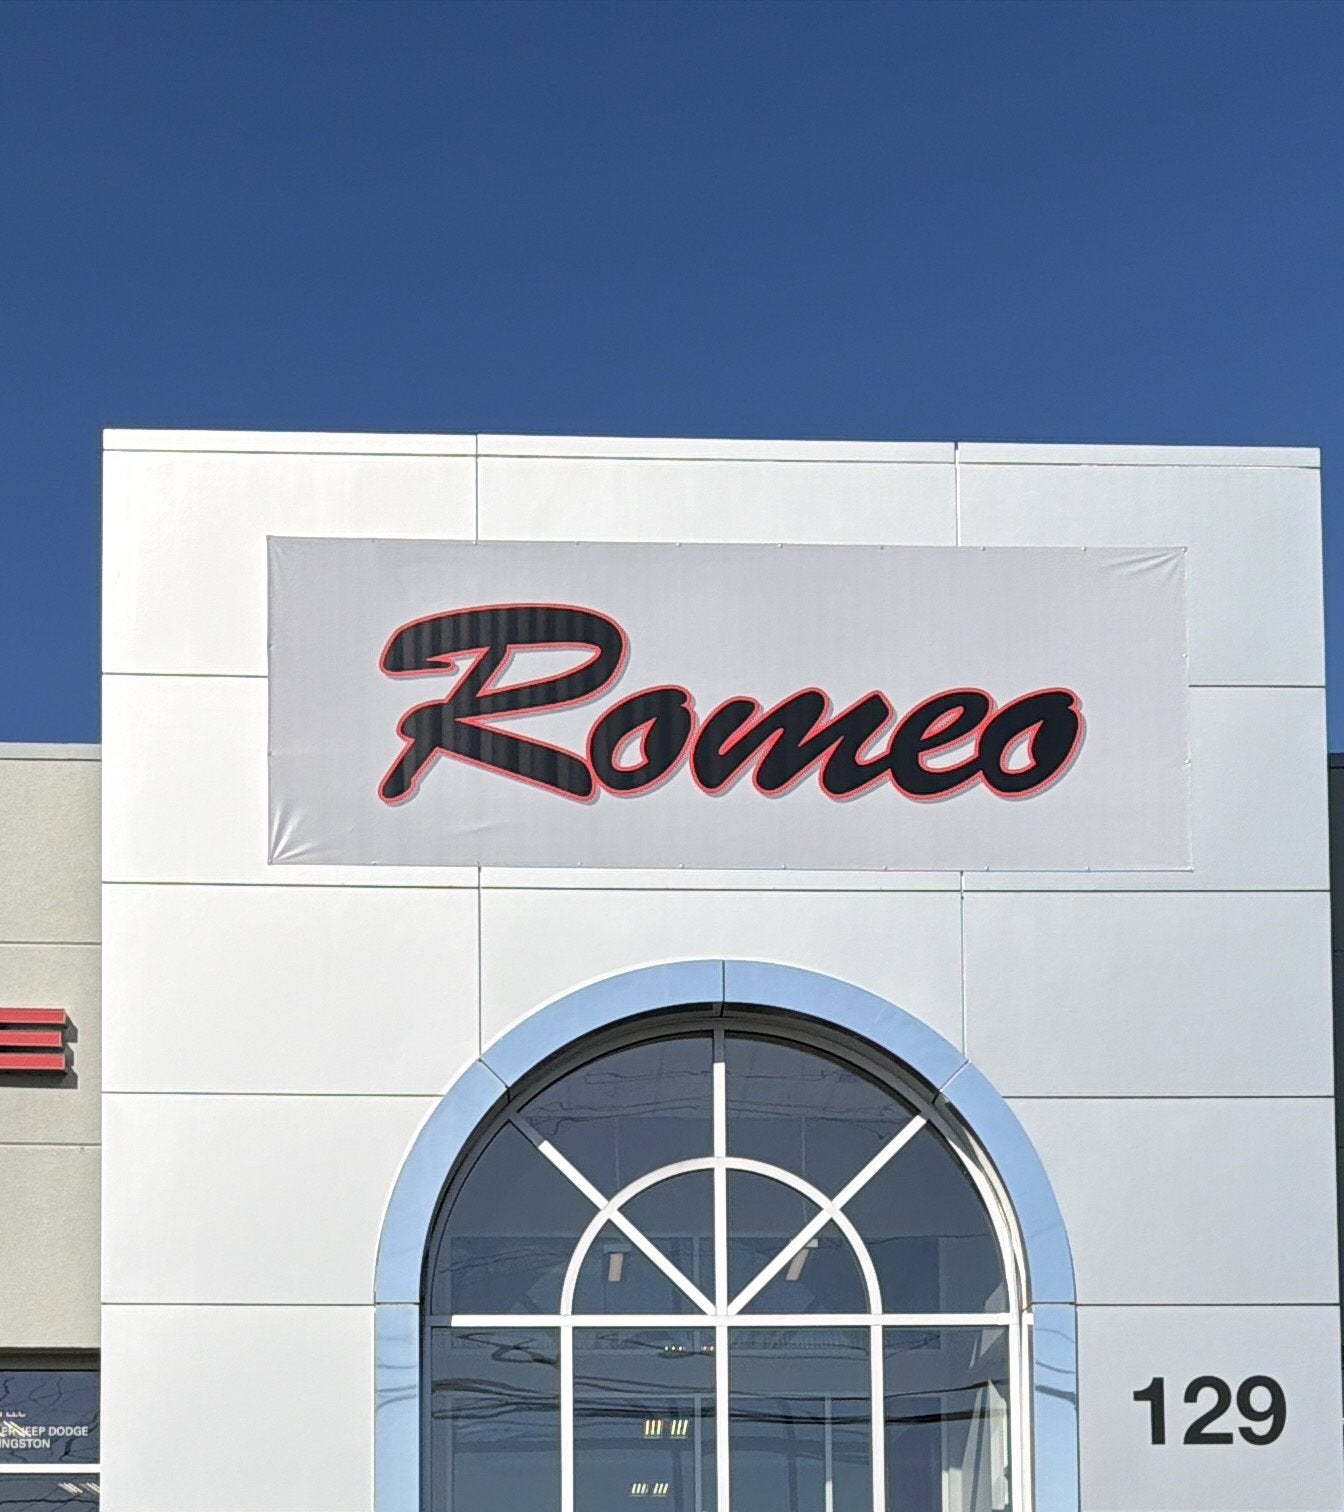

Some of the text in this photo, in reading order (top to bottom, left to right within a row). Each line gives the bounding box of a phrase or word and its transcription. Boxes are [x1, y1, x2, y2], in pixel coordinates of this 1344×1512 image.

[378, 602, 1085, 802] Romeo
[48, 1426, 89, 1437] DODGE
[1132, 1374, 1287, 1446] 129
